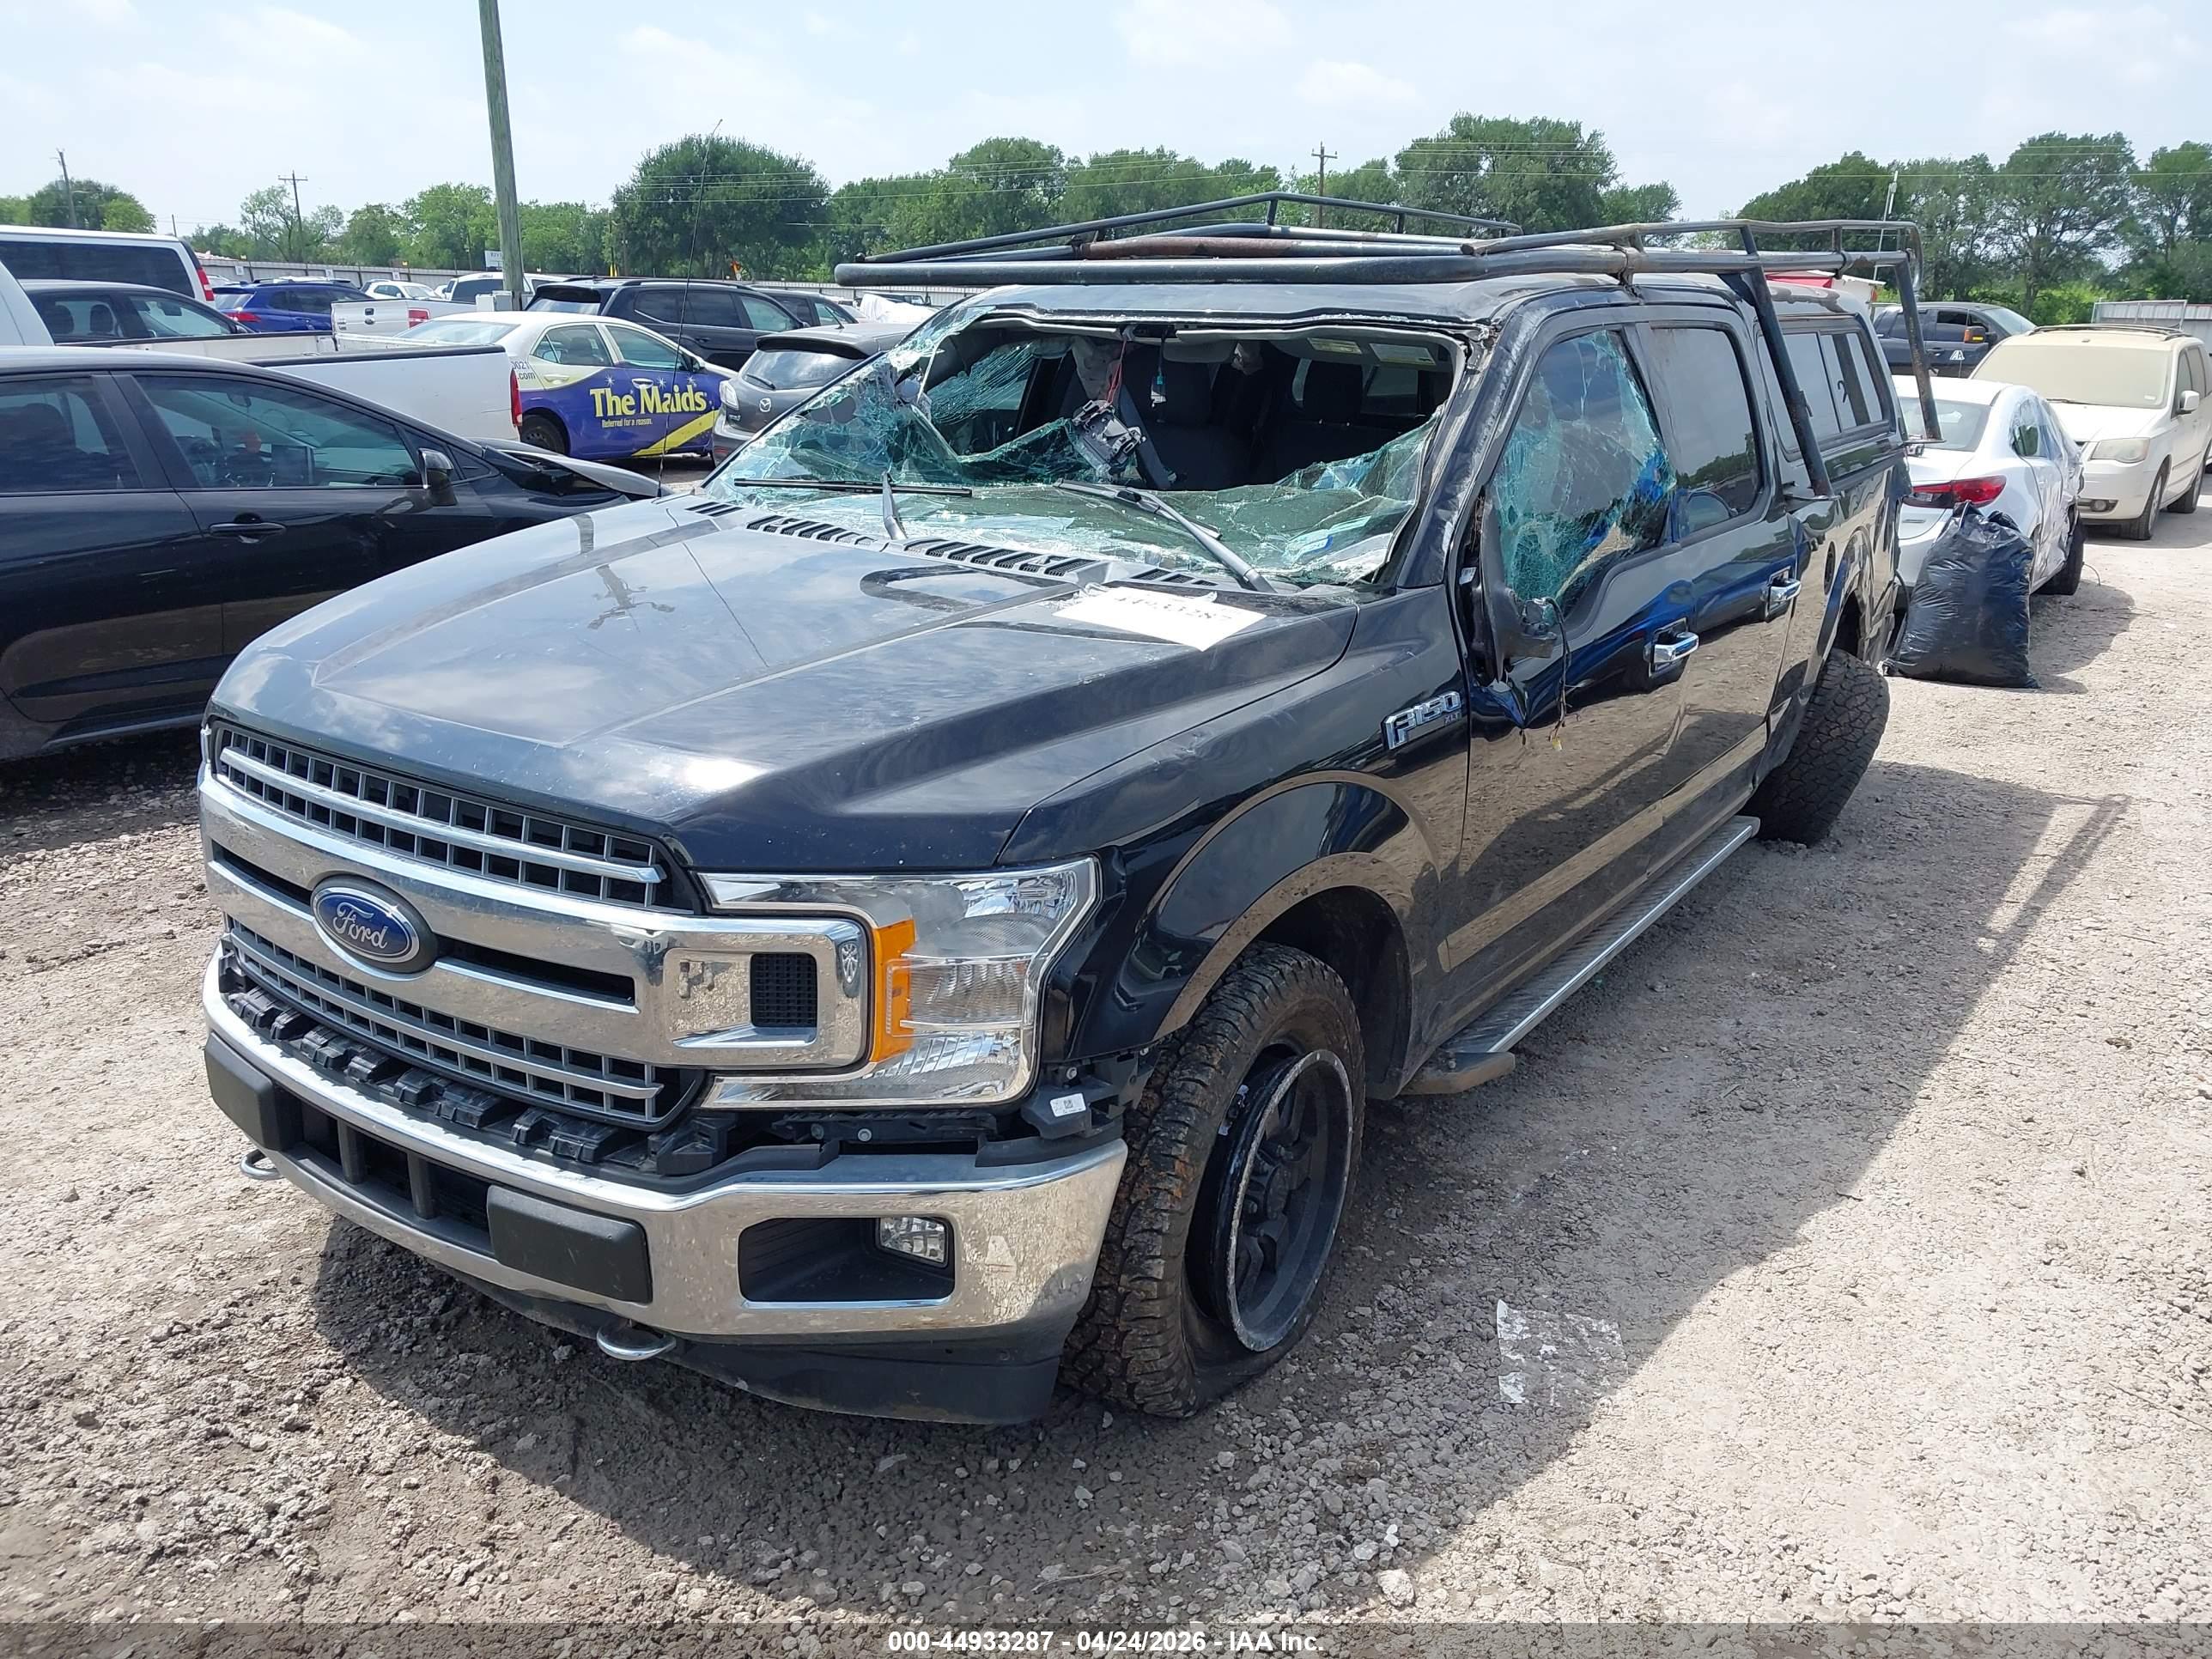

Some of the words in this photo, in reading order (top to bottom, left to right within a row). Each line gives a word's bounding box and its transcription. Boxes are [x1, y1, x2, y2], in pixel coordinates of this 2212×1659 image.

[589, 387, 636, 417] The
[639, 384, 708, 414] Maids
[1444, 712, 1461, 727] XLT
[332, 902, 389, 949] Ford
